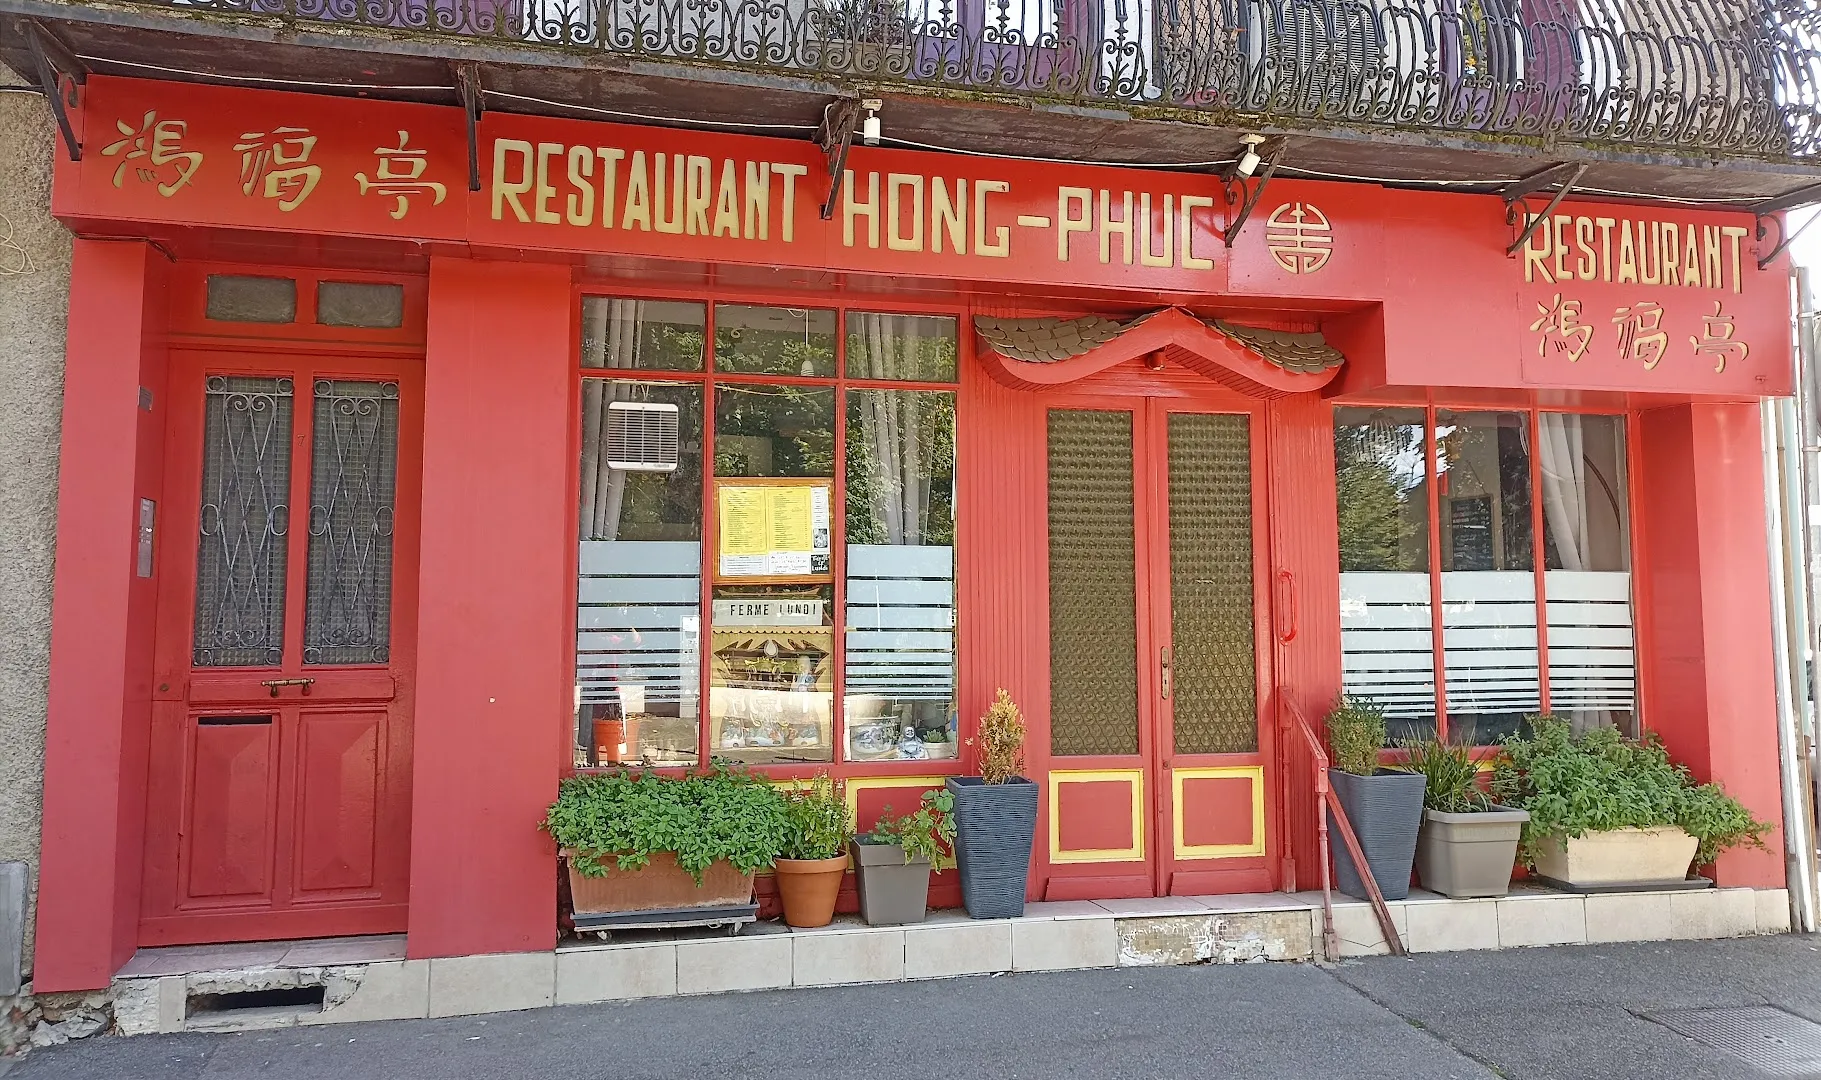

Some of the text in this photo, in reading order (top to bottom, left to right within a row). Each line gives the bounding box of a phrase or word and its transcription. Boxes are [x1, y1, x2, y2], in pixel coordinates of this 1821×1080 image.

[491, 138, 1214, 270] RESTAURANT HONG-PHUC
[1522, 212, 1749, 295] RESTAURANT
[730, 603, 816, 616] FERME LUNDI
